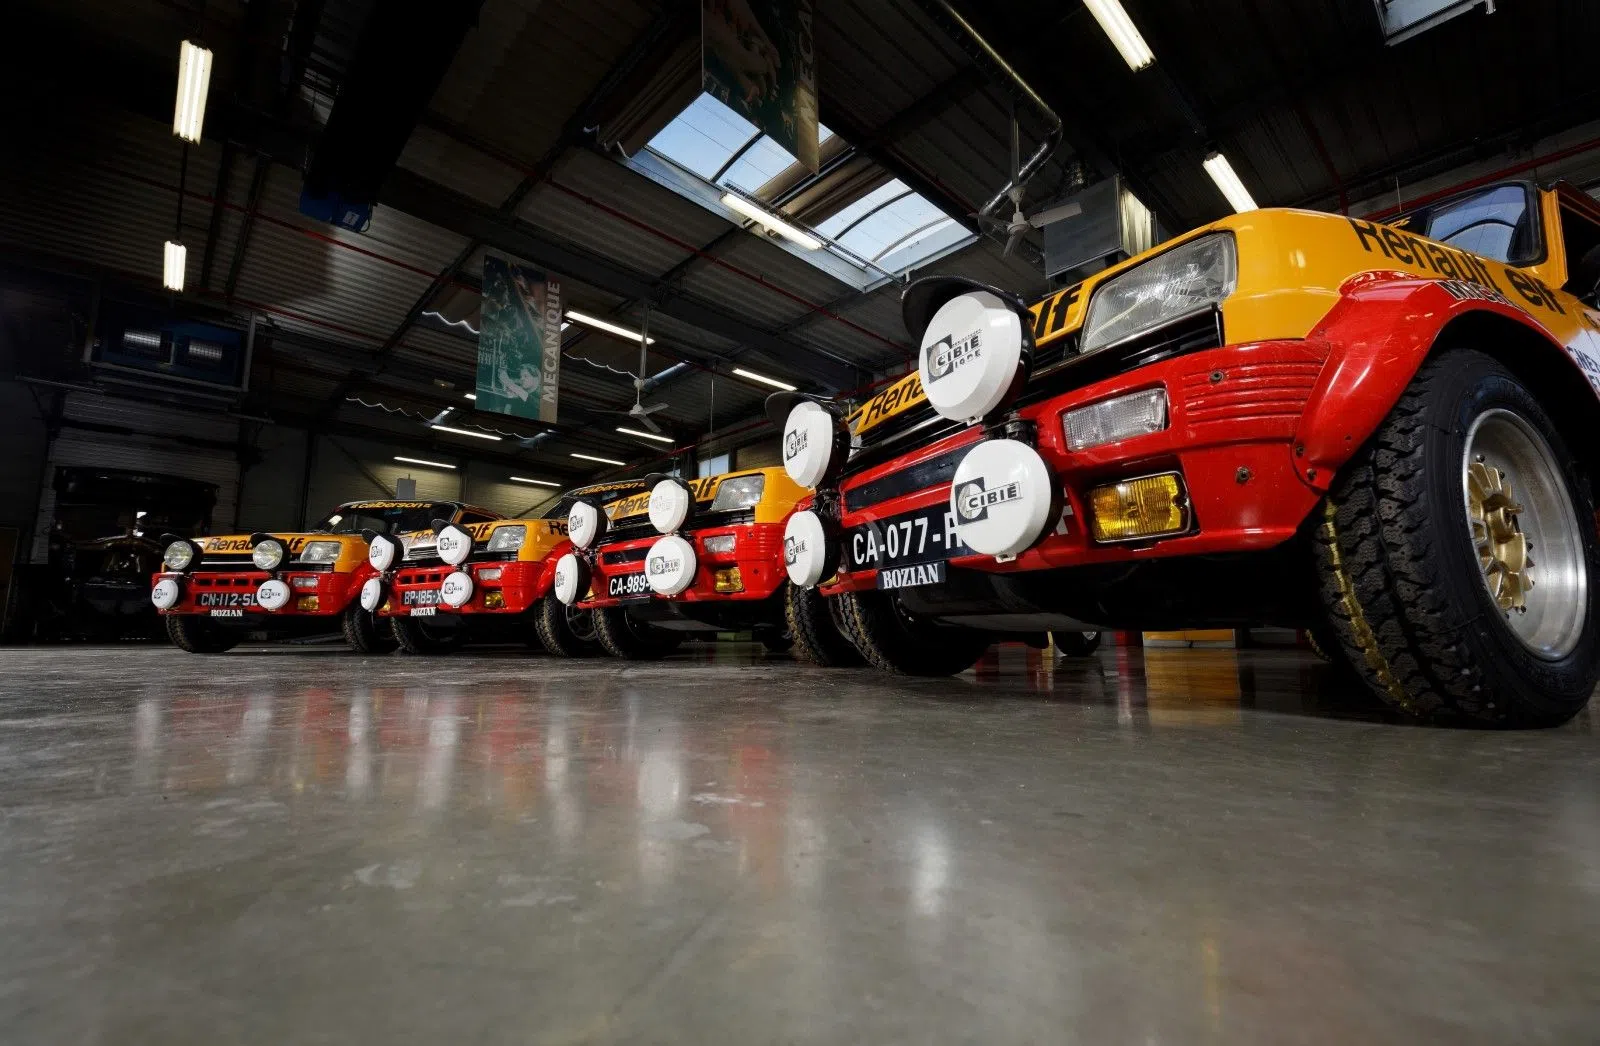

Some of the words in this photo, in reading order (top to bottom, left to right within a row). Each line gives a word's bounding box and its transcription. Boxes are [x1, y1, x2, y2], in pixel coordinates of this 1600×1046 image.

[1348, 217, 1504, 295] Renault
[1504, 267, 1566, 315] elf
[543, 281, 561, 403] MECANIQUE
[864, 377, 925, 426] Rena
[1034, 282, 1083, 338] lf
[852, 510, 964, 565] CA-077-R
[609, 574, 653, 595] CA-989-
[881, 563, 939, 590] BOZIAN
[404, 590, 443, 605] BP-185-X
[410, 607, 436, 617] BOZIAN
